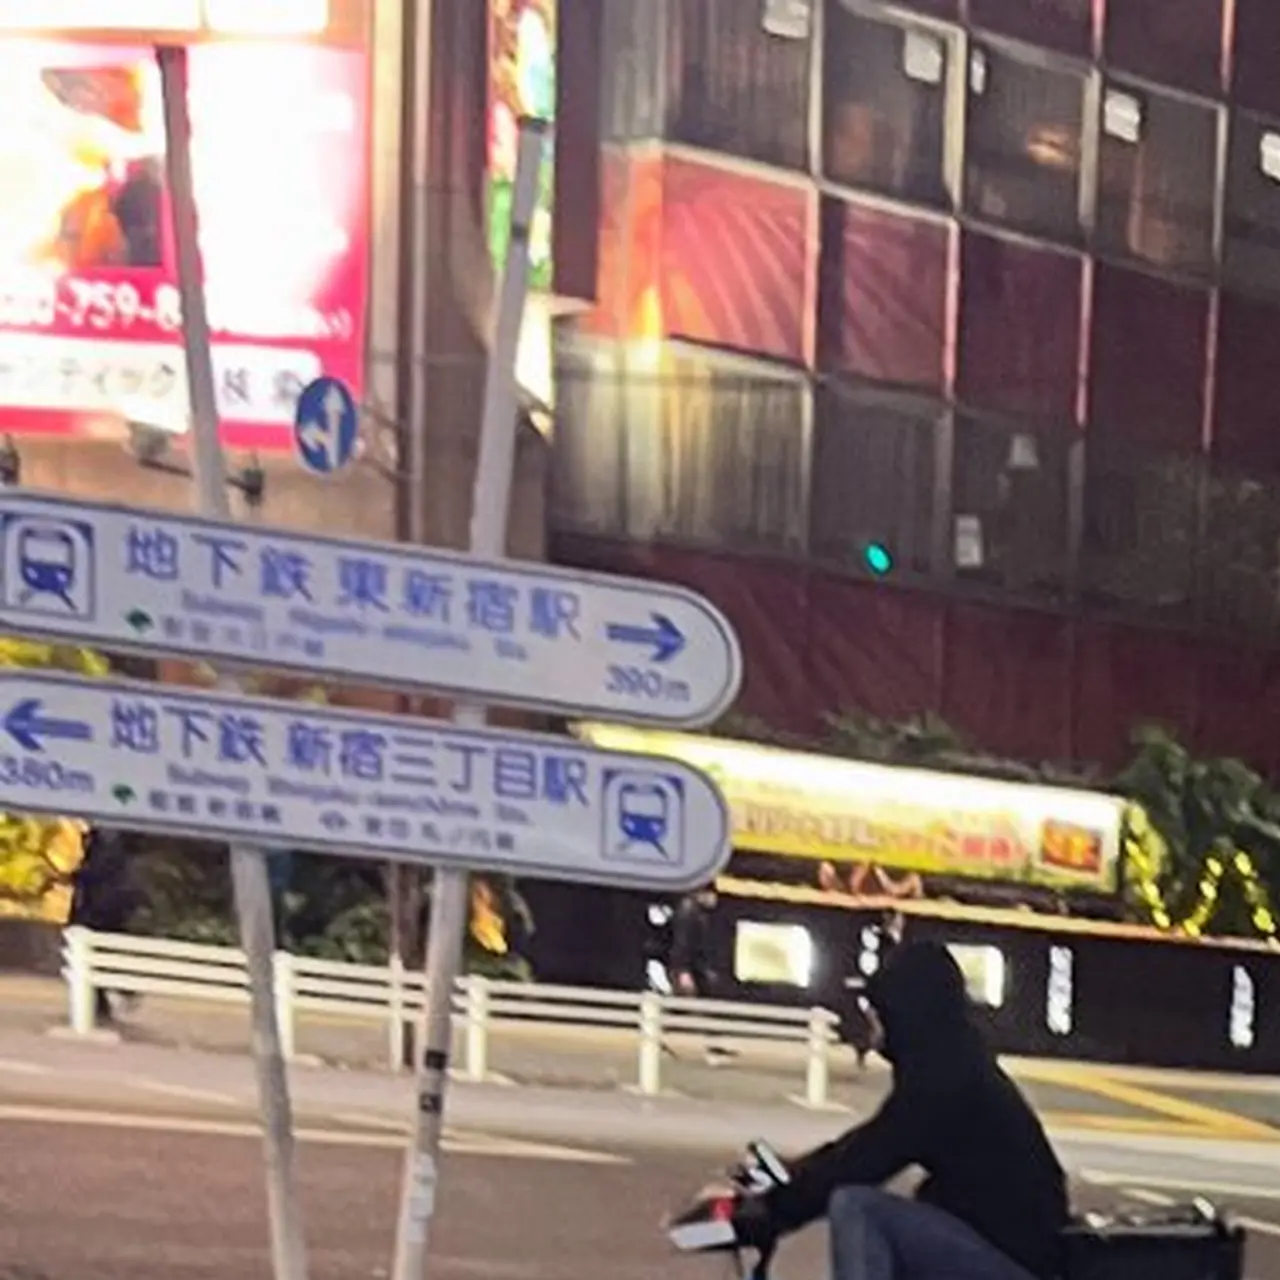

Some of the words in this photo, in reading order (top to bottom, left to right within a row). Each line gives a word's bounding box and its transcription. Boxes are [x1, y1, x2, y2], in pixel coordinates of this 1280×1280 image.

[125, 525, 313, 601] 地下鉄
[335, 556, 581, 641] 東新宿駅
[111, 699, 268, 768] 地下鉄
[287, 722, 589, 806] 新宿三丁目駅
